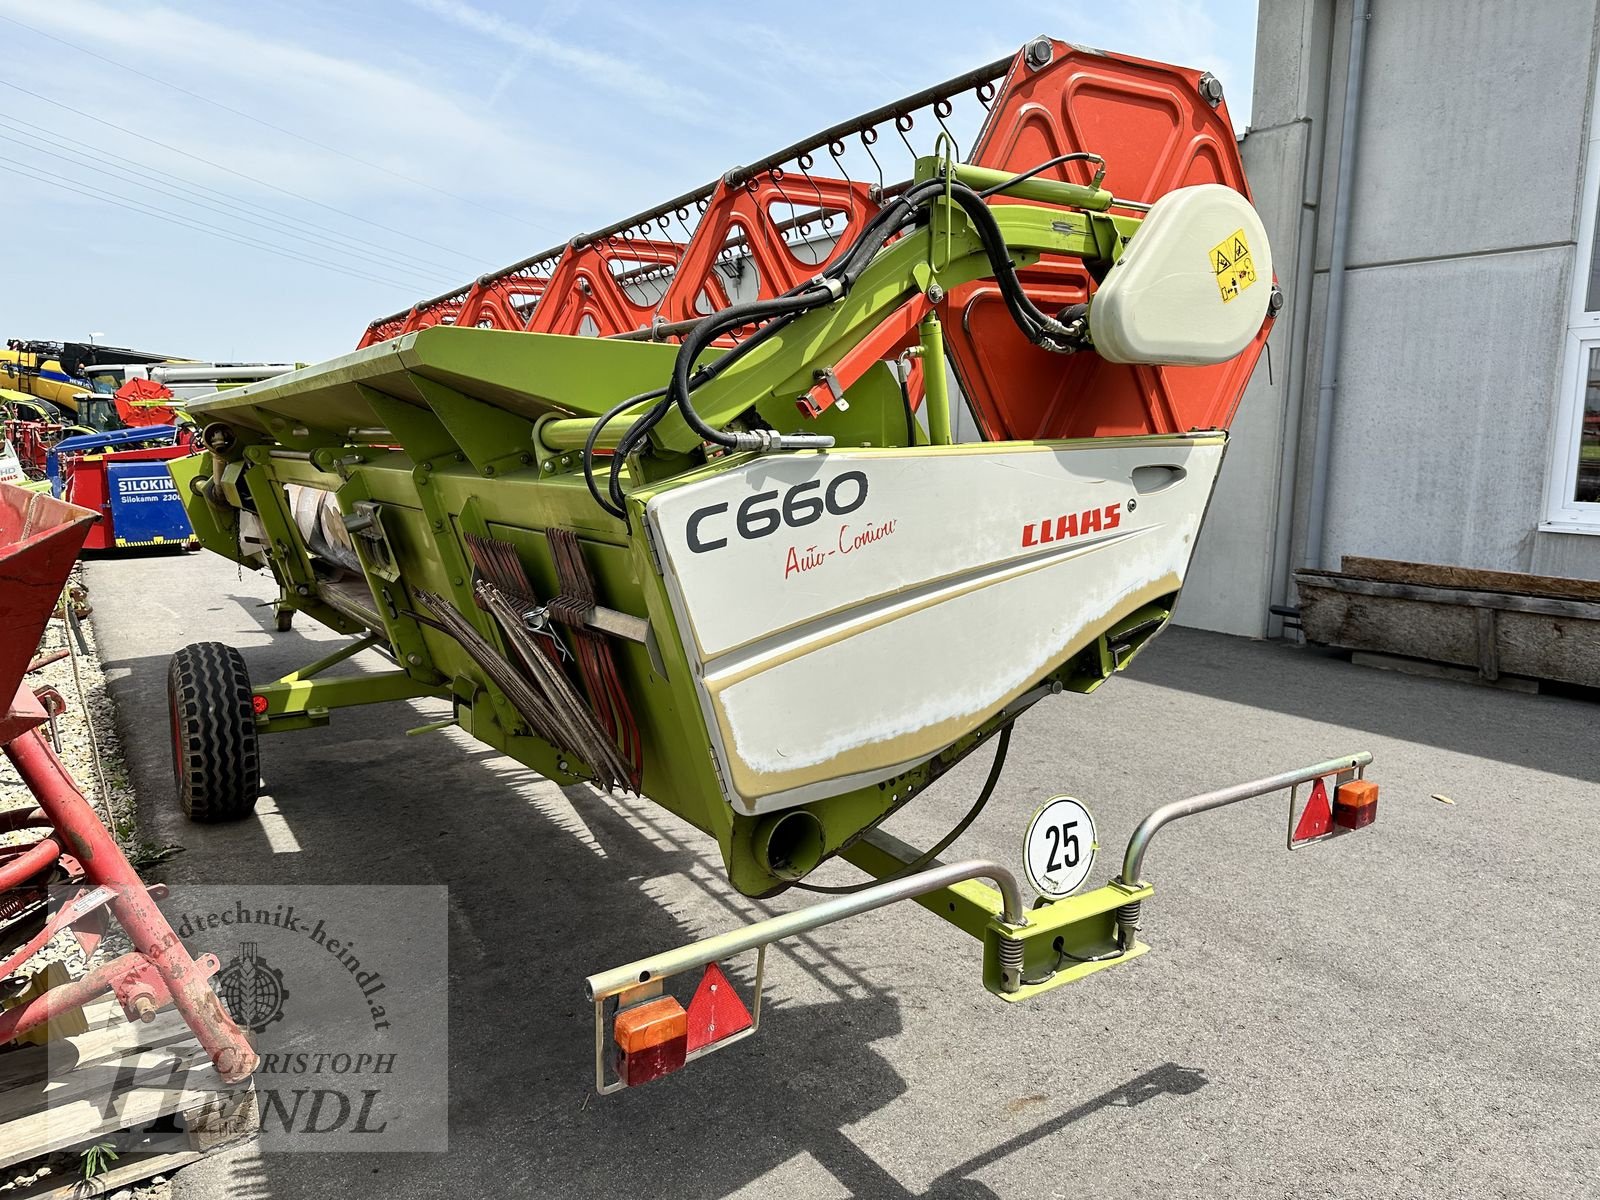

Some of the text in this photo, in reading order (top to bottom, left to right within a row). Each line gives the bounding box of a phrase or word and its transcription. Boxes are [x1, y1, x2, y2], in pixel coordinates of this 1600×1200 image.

[118, 479, 175, 491] SILOKIN
[121, 495, 159, 503] Silokamm
[1022, 503, 1121, 548] CLAAS
[1045, 821, 1080, 873] 25
